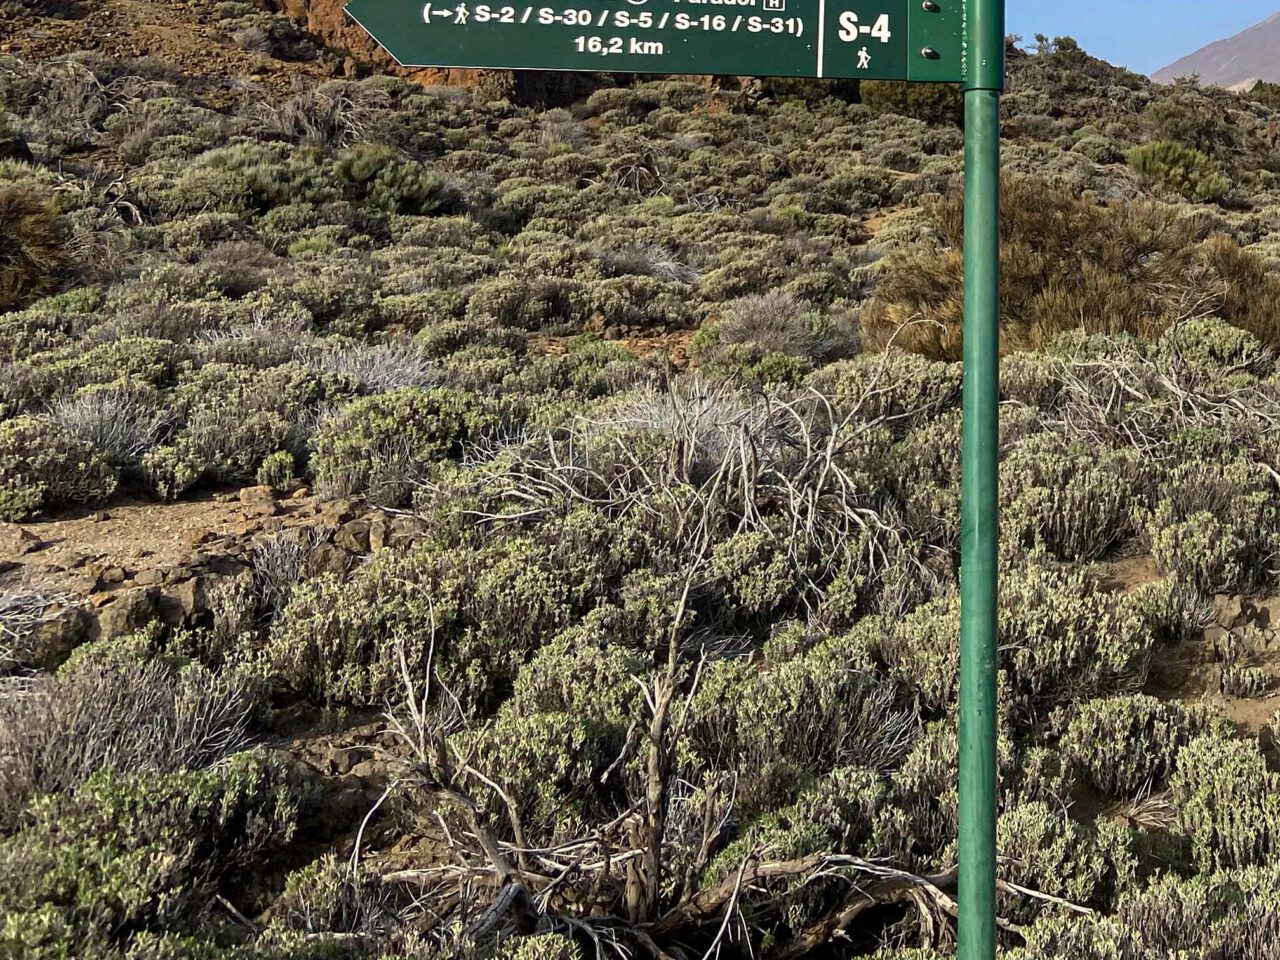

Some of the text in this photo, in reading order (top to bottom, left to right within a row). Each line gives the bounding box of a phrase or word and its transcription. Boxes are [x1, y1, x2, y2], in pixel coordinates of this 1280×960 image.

[473, 4, 515, 24] S-2
[538, 7, 594, 26] S-30
[614, 11, 653, 28] S-5
[674, 12, 727, 31] S-16
[747, 15, 804, 37] S-31)
[838, 10, 892, 43] S-4
[573, 35, 664, 57] 16,2 km
